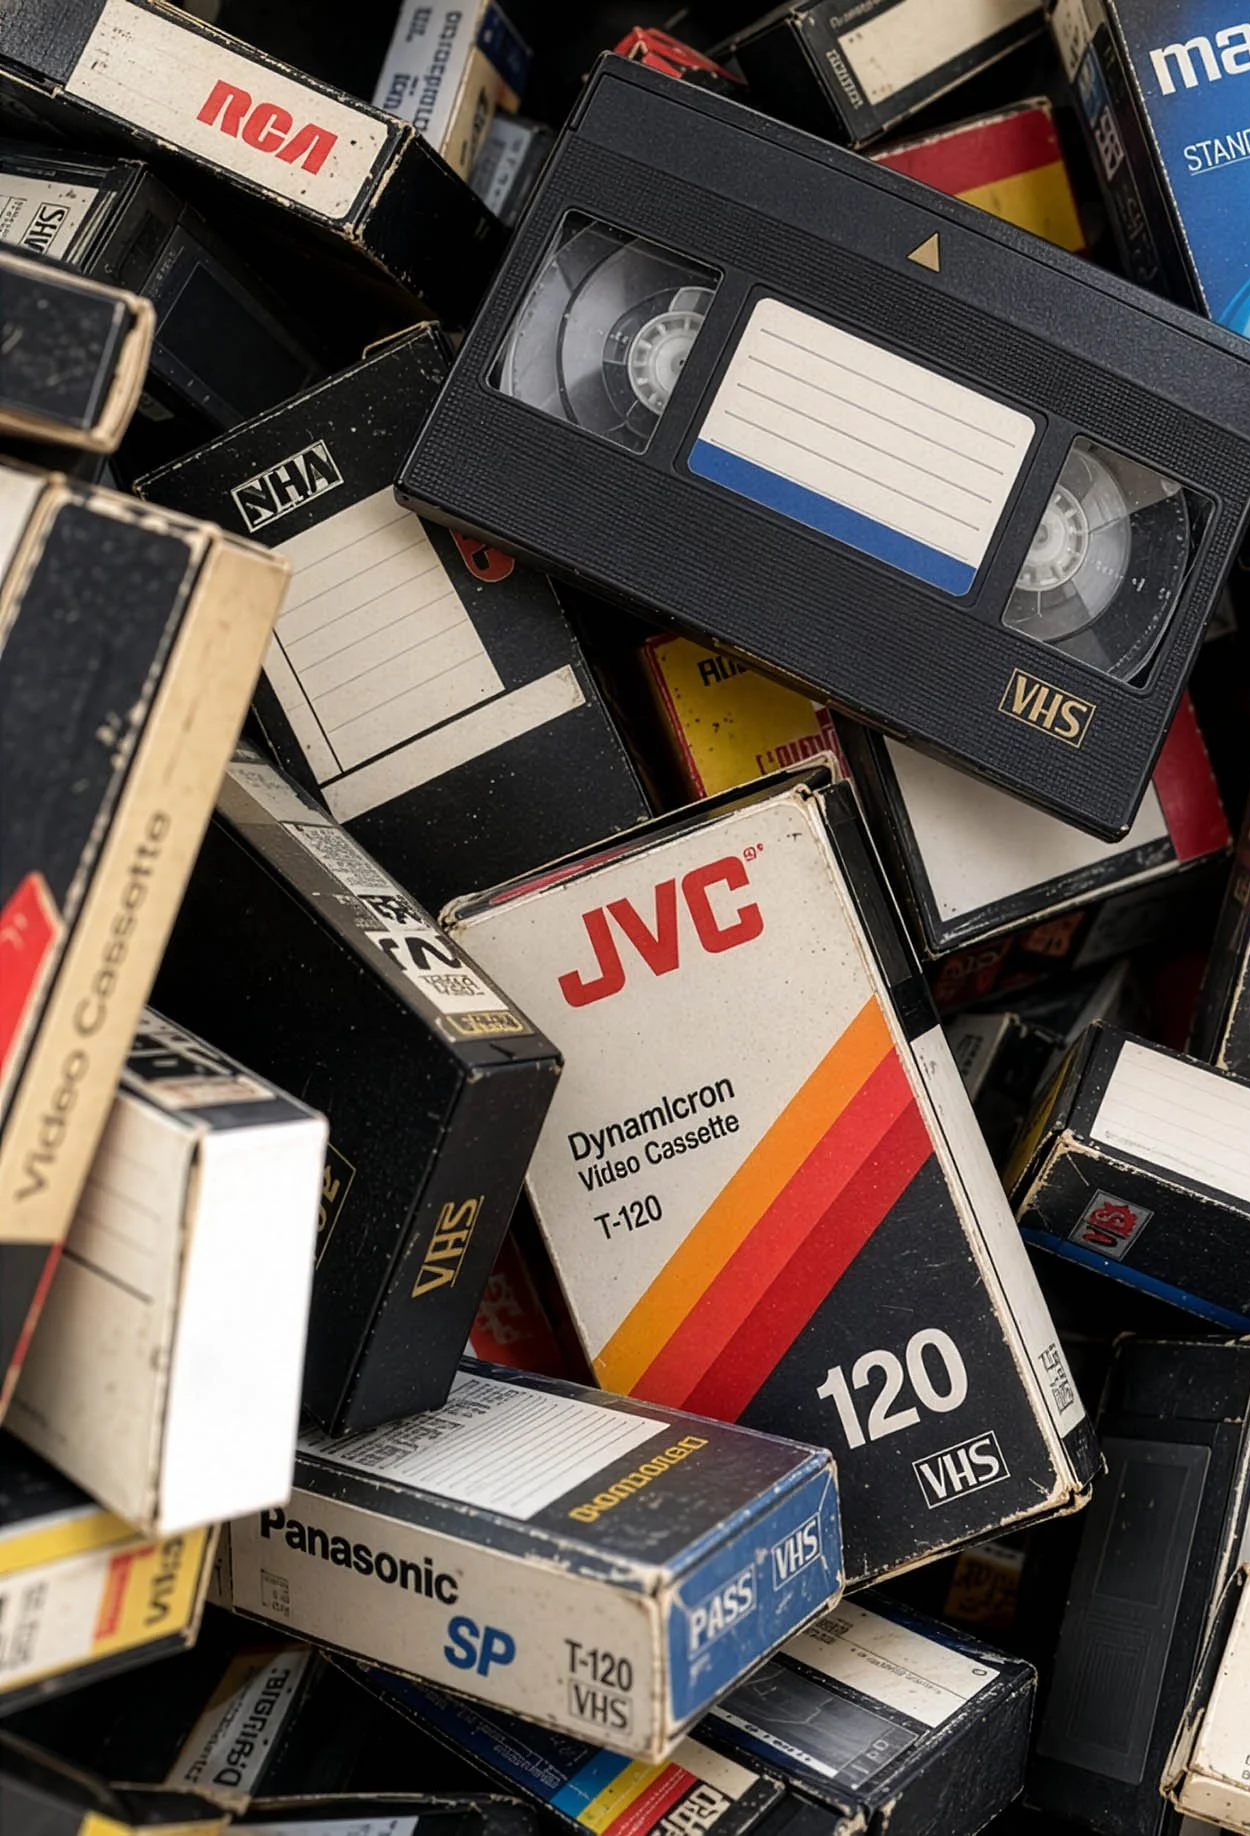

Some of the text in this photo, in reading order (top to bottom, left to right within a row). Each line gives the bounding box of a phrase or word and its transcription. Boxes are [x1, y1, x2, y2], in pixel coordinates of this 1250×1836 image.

[197, 79, 338, 176] RCA
[1012, 674, 1088, 738] VHS
[557, 855, 765, 1008] JVC
[645, 1114, 740, 1165] Cassette
[411, 1198, 479, 1299] VHS
[593, 1194, 663, 1240] T-120
[816, 1327, 969, 1450] 120
[919, 1438, 1000, 1499] VHS
[260, 1507, 460, 1606] Panasonic
[775, 1517, 819, 1581] VHS
[689, 1571, 754, 1652] PASS
[443, 1615, 517, 1678] SP
[564, 1638, 633, 1693] T-120
[573, 1685, 629, 1730] VHS
